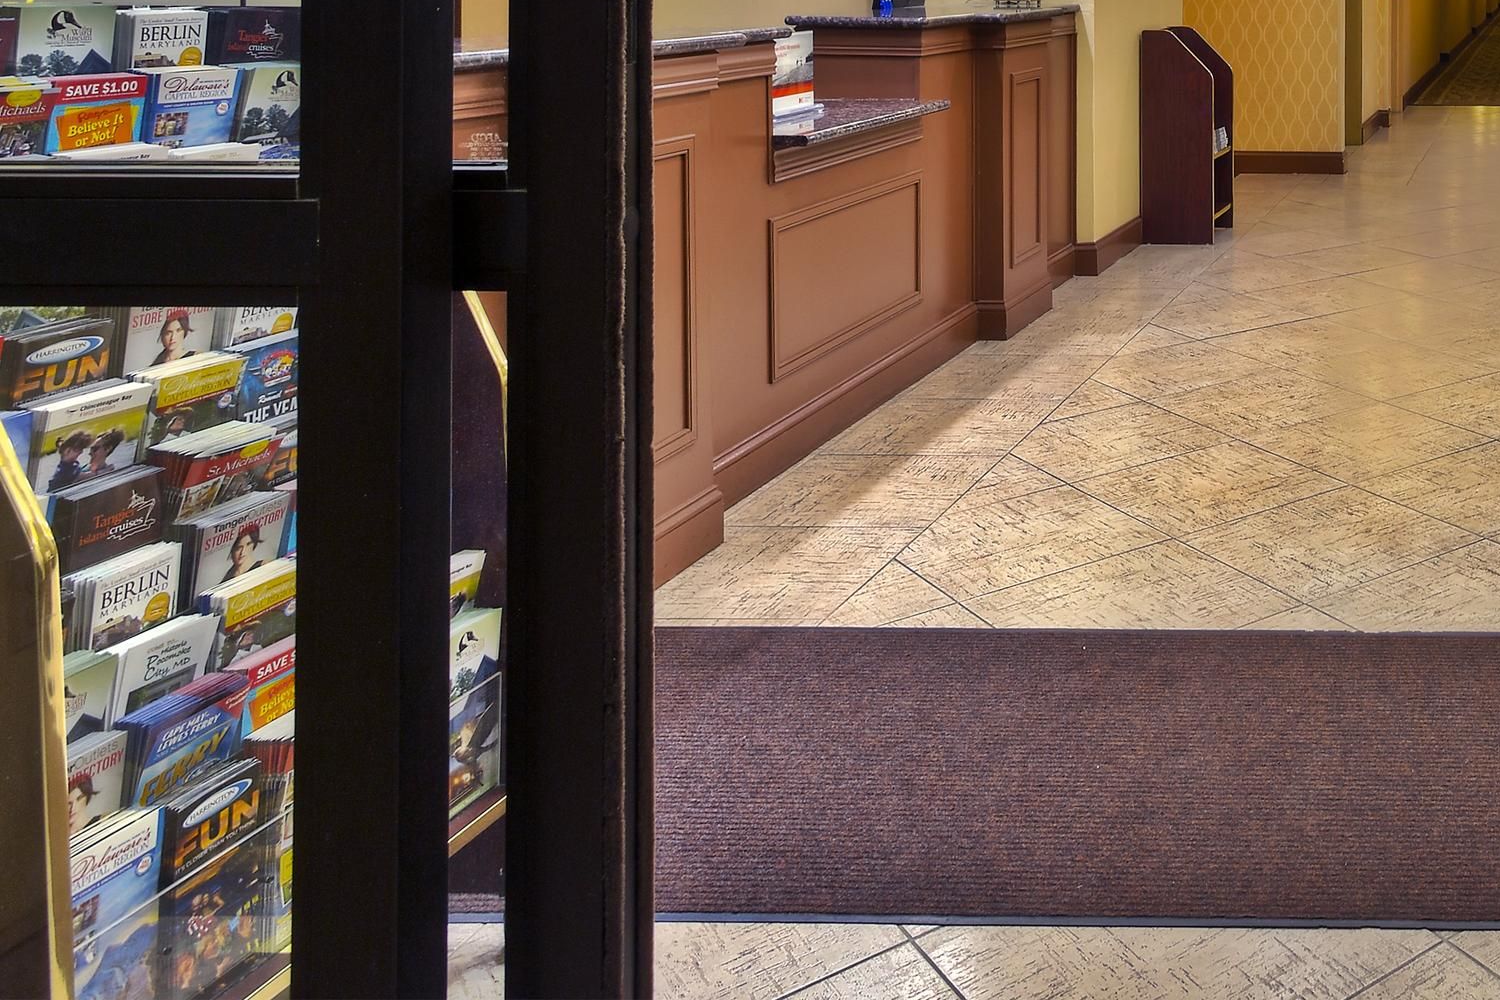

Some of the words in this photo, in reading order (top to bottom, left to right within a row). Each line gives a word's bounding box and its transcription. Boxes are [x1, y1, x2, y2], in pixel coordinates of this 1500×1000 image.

[141, 24, 201, 42] BERLIN
[139, 39, 201, 49] MARYLAND
[66, 83, 100, 97] SAVE
[102, 80, 138, 95] $1.00
[165, 90, 197, 101] CAPITAL
[68, 119, 111, 137] Believe
[113, 113, 124, 126] It
[75, 137, 88, 147] or
[91, 126, 117, 144] Not!
[132, 311, 162, 328] STORE
[35, 342, 87, 359] HARRINGTON
[12, 348, 111, 401] FUN
[94, 508, 134, 529] Tangier
[109, 517, 144, 535] cruises
[205, 531, 235, 552] STORE
[238, 506, 288, 537] DIRECTORY
[101, 564, 171, 610] BERLIN
[100, 582, 169, 618] MARYLAND
[146, 646, 192, 671] Pocomoke
[173, 657, 191, 669] MD
[257, 654, 288, 680] SAVE
[157, 731, 190, 753] LEWES
[189, 713, 221, 738] FERRY
[162, 722, 187, 741] CAPE
[189, 788, 236, 821] HARRINGTON
[175, 789, 259, 868] FUN
